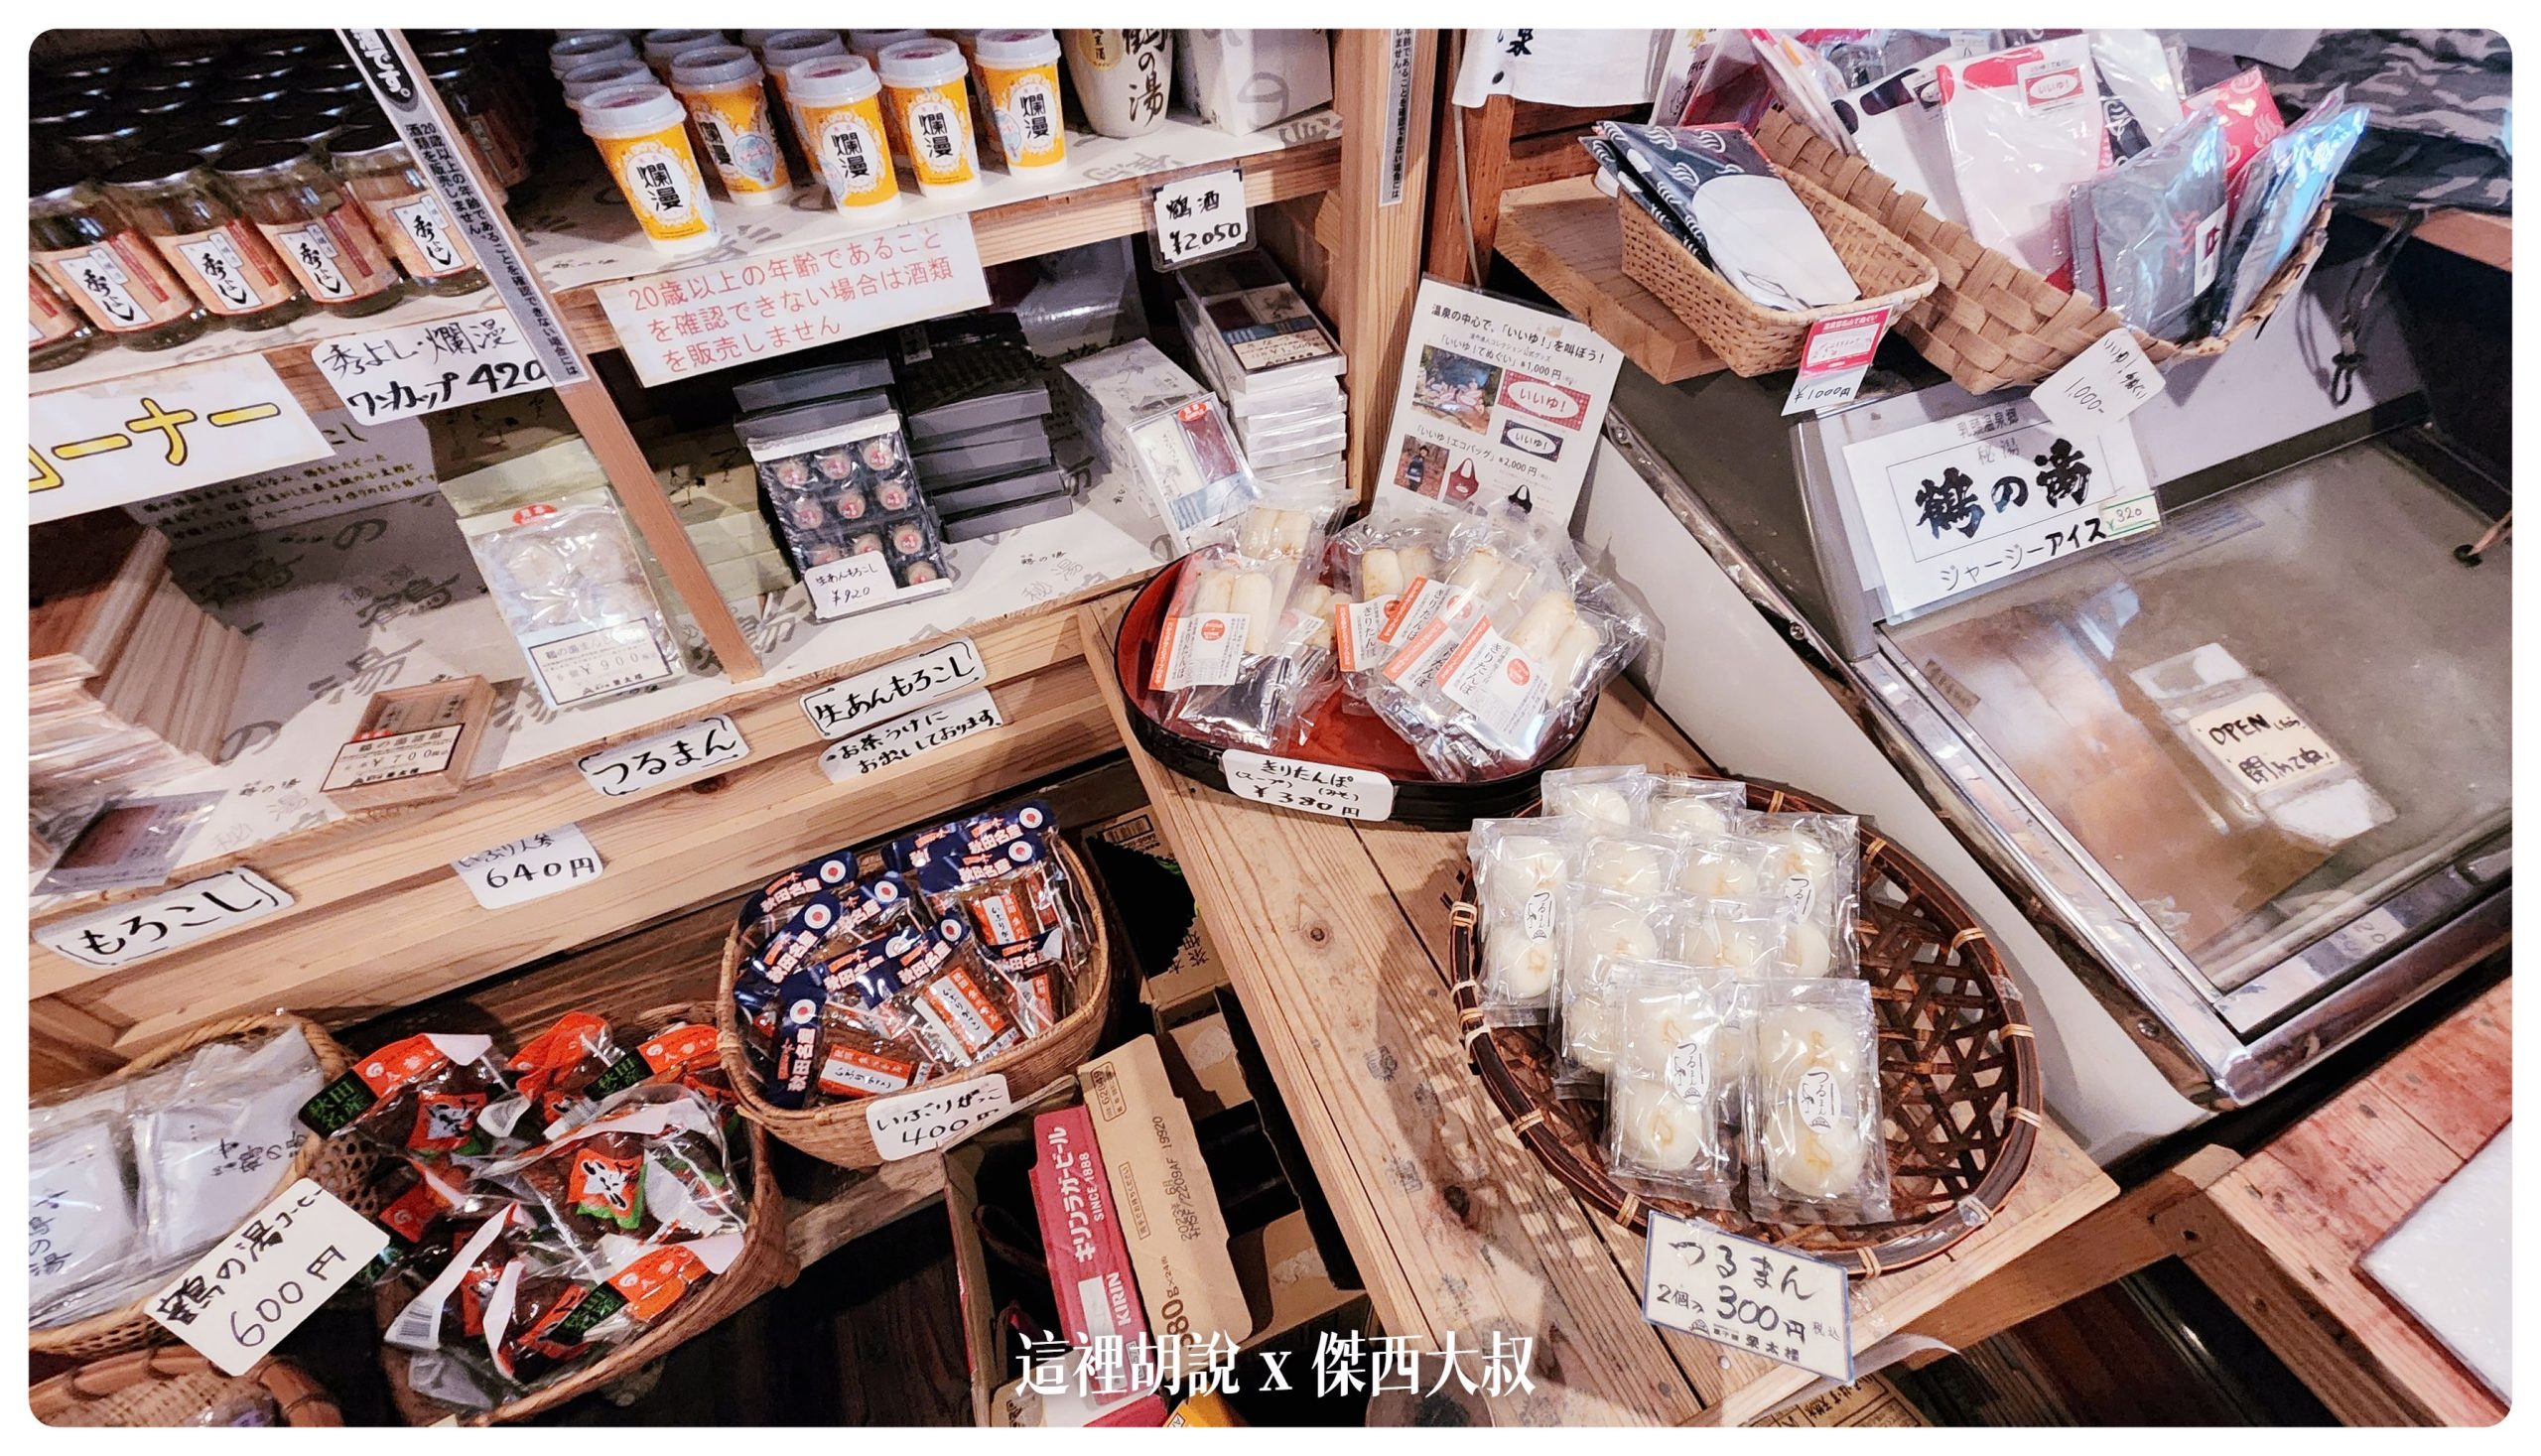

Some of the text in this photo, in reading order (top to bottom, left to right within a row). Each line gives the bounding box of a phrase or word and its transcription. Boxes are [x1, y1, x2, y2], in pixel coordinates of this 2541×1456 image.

[918, 112, 953, 158] 爛漫
[1019, 92, 1049, 139] 爛漫
[831, 132, 870, 178] 爛漫
[636, 163, 684, 211] 爛漫
[627, 225, 943, 313] 20歳以上の年齢であること
[647, 255, 953, 342] を確認できない場合は酒類
[665, 320, 842, 373] を販売しません
[1915, 438, 2092, 540] 鶴の湯
[1940, 517, 2107, 592] ジャージーアイス
[815, 656, 975, 728] 生あんもろこし
[593, 729, 736, 784] つるまん
[2208, 714, 2271, 745] OPEN
[1261, 759, 1354, 789] きりたんぽ
[486, 858, 596, 888] 640円
[84, 881, 264, 958] もろこし
[1048, 1126, 1096, 1263] キリンラガービール
[1079, 1152, 1105, 1222] SINCE 1888
[230, 1245, 347, 1347] 600円
[1106, 1272, 1132, 1326] KIRIN
[1669, 1241, 1817, 1300] つるまん
